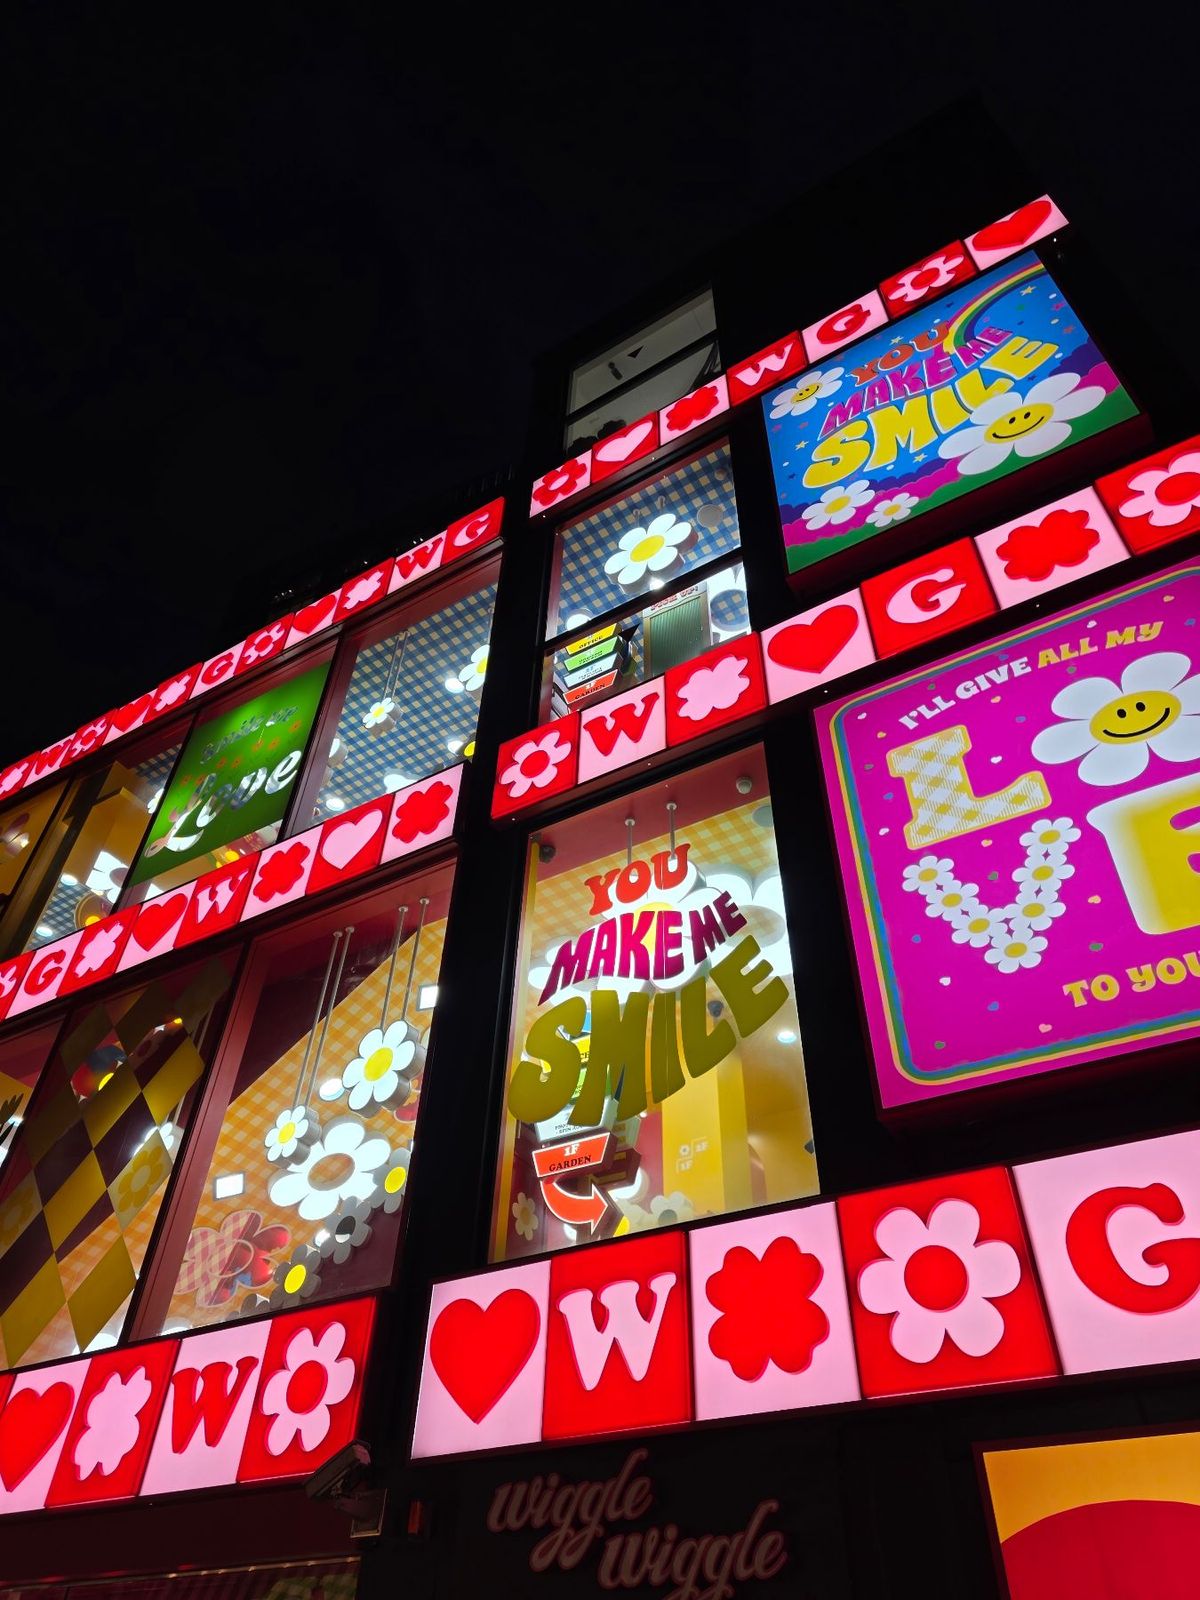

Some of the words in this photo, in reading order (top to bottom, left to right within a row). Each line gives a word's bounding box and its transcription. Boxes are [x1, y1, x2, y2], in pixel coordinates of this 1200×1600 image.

[818, 345, 957, 440] MAKE
[954, 327, 1013, 368] ME
[850, 320, 950, 386] YOU
[803, 336, 1058, 488] SMILE
[886, 566, 967, 624] G
[202, 652, 234, 684] G
[575, 683, 606, 700] GARDEN
[898, 696, 956, 730] I'LL
[955, 657, 1032, 700] GIVE
[1037, 637, 1098, 669] ALL
[1105, 621, 1163, 649] MY
[583, 692, 660, 756] W
[143, 750, 302, 858] Love
[197, 868, 249, 924] W
[584, 843, 691, 916] YOU
[24, 949, 66, 996] G
[538, 910, 685, 1006] MAKE
[688, 890, 748, 964] ME
[507, 934, 790, 1127] SMILE
[1062, 974, 1120, 1008] TO
[549, 1154, 592, 1173] GARDEN
[564, 1143, 580, 1157] 1F
[1066, 1183, 1200, 1315] G
[557, 1271, 677, 1392] W
[171, 1356, 259, 1454] W
[486, 1447, 654, 1573] wiggle
[598, 1498, 790, 1600] wiggle
